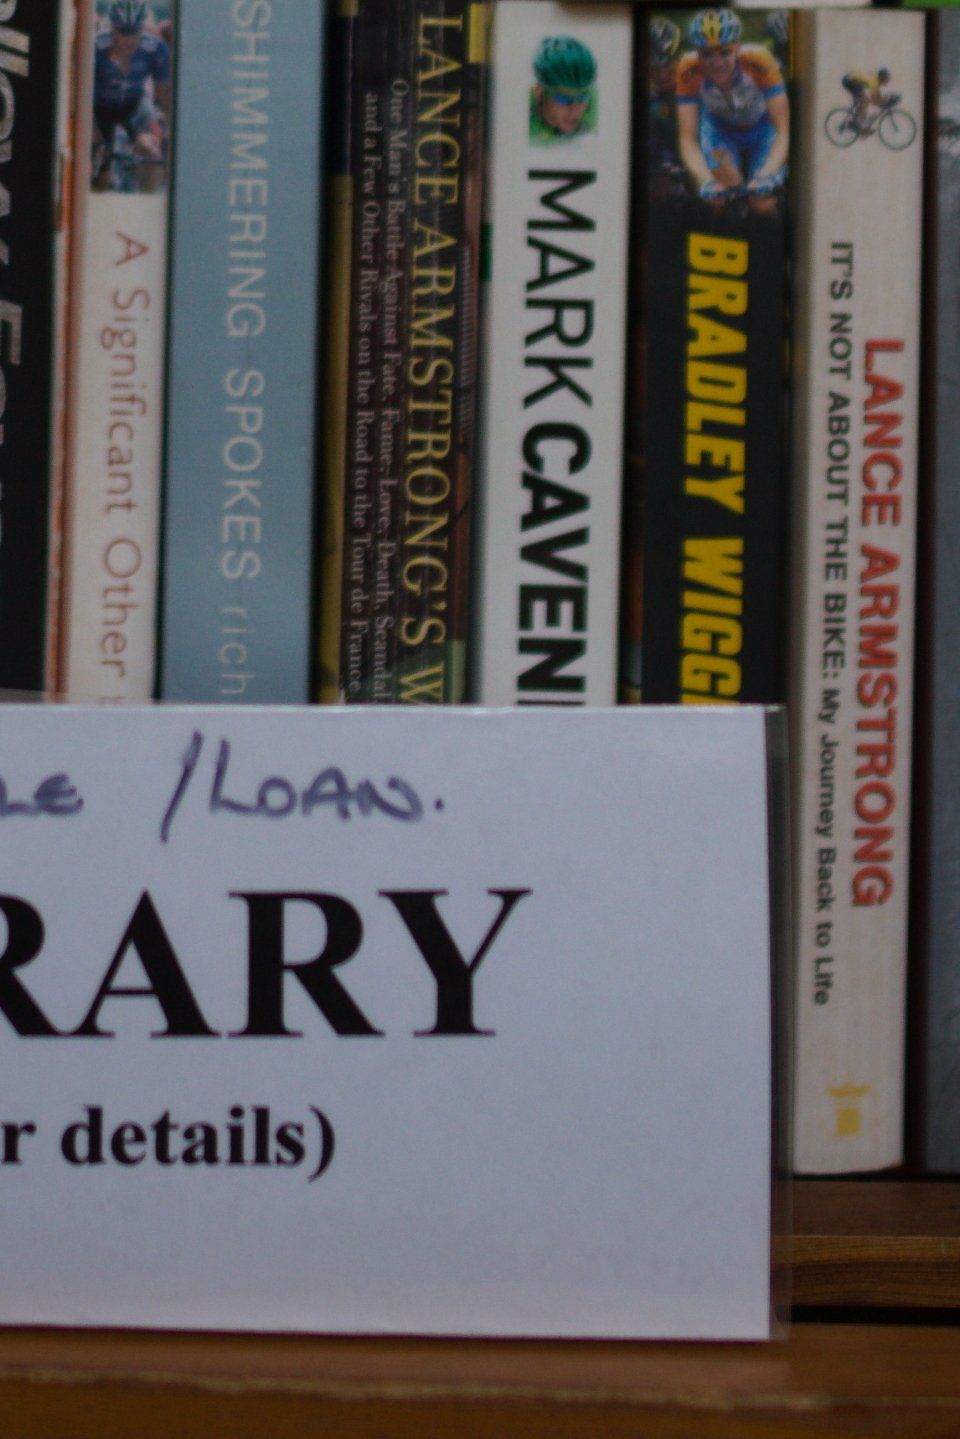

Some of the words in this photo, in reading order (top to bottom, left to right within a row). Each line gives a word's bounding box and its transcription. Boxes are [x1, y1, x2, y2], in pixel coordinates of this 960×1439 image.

[362, 90, 383, 134] and
[387, 78, 411, 120] One
[412, 12, 463, 207] LANCE
[359, 153, 382, 193] Few
[385, 125, 409, 193] Man's
[116, 232, 149, 266] A
[359, 198, 381, 262] Other
[383, 195, 408, 261] Battle
[355, 267, 379, 333] Rivals
[521, 169, 598, 411] MARK
[828, 240, 855, 301] IT'S
[377, 266, 403, 346] Against
[376, 350, 401, 402] Fate,
[683, 231, 750, 514] BRADLEY
[827, 311, 853, 379] NOT
[99, 287, 149, 514] Significant
[355, 371, 376, 405] the
[353, 409, 376, 460] Road
[374, 407, 398, 471] Fame,
[397, 216, 460, 648] ARMSTRONG'S
[825, 390, 852, 509] ABOUT
[859, 338, 906, 527] LANCE
[219, 367, 264, 582] SPOKES
[373, 476, 398, 535] Love,
[352, 493, 373, 526] the
[349, 532, 371, 581] Tour
[372, 540, 396, 610] Death,
[823, 517, 849, 582] THE
[98, 537, 144, 679] Other
[820, 591, 847, 680] BIKE:
[813, 688, 840, 725] My
[852, 542, 901, 907] ARMSTRONG
[811, 732, 839, 838] Journey
[814, 847, 837, 913] Back
[813, 919, 836, 948] to
[812, 956, 836, 1006] Life
[60, 1103, 337, 1182] details)
